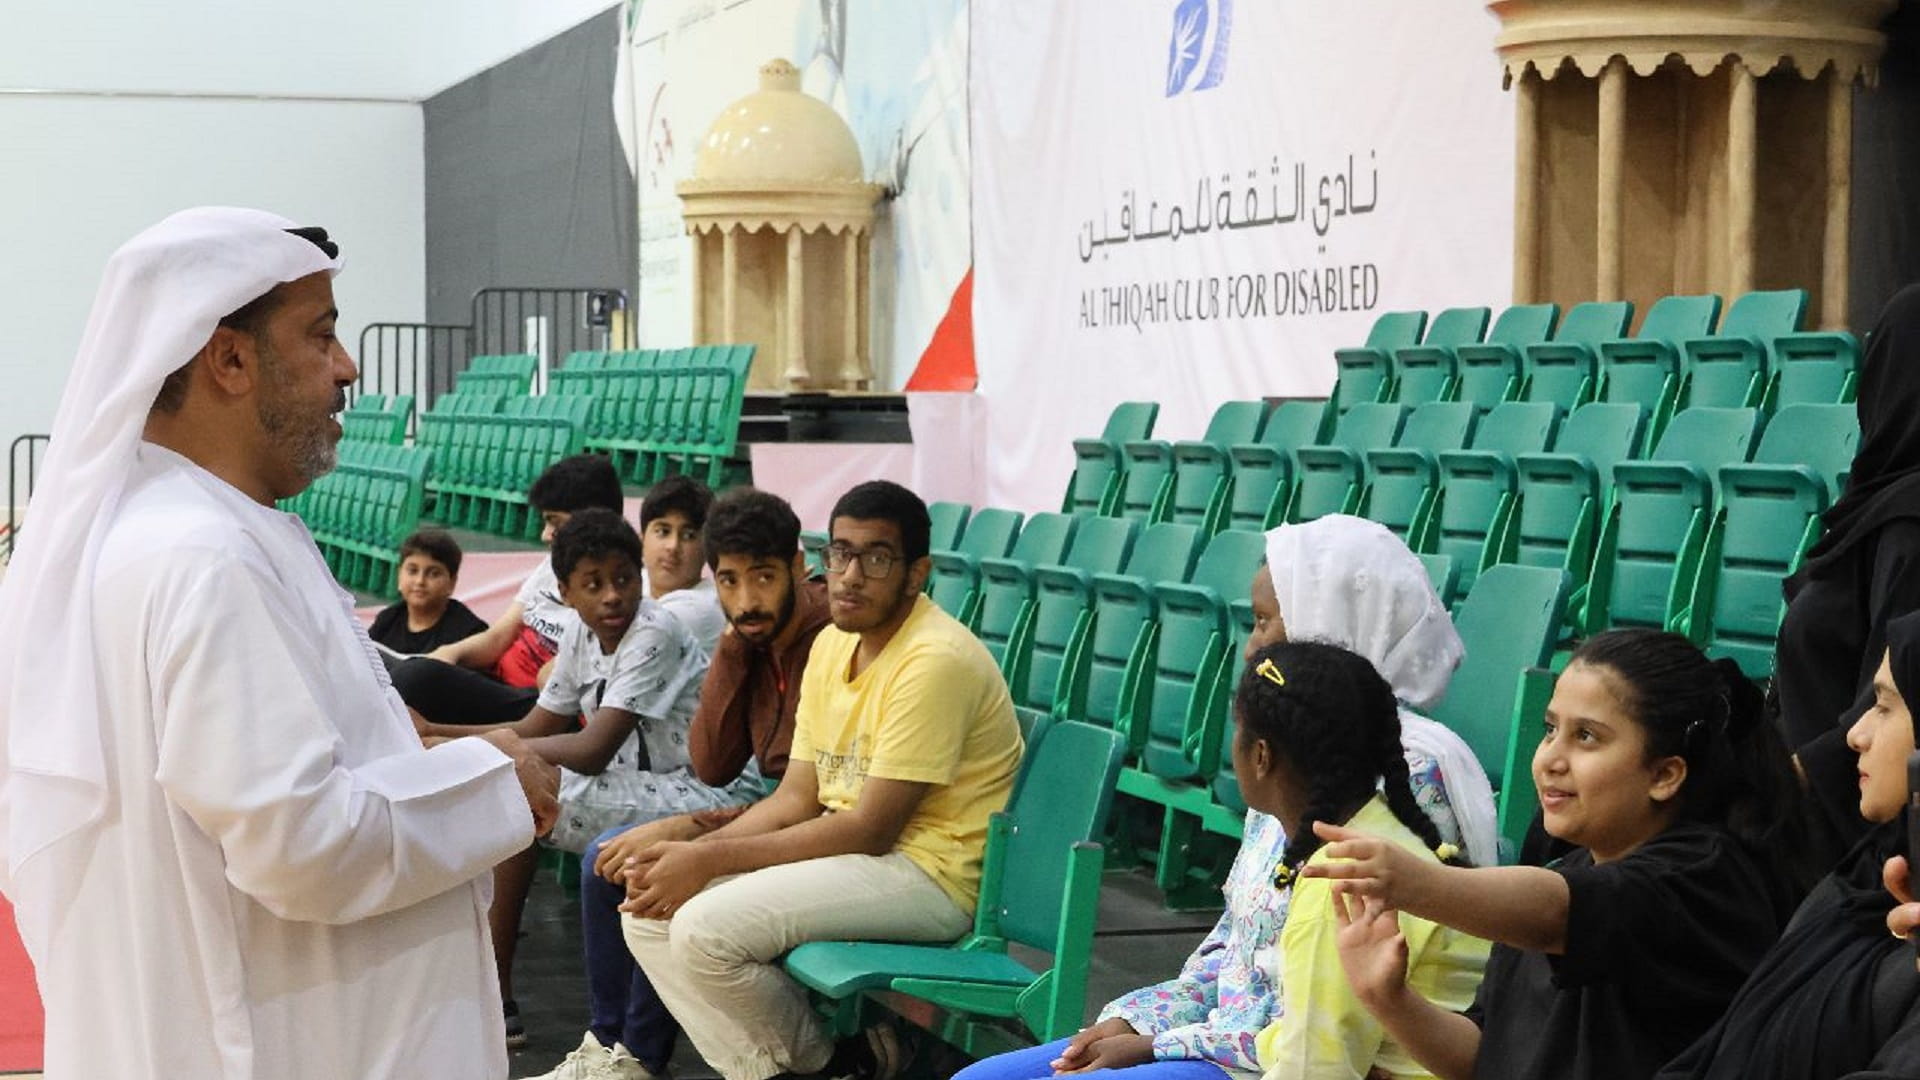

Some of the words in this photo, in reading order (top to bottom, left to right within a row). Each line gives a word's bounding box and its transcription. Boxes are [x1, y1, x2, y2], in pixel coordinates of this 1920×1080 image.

[1078, 177, 1211, 263] للمعاقين
[1216, 156, 1304, 231] الثقة
[1312, 149, 1377, 253] نادي
[1079, 289, 1098, 328] AL
[1102, 279, 1168, 334] THIQAH
[1174, 277, 1219, 322] CLUB
[1227, 273, 1267, 318] FOR
[1275, 263, 1379, 316] DISABLED
